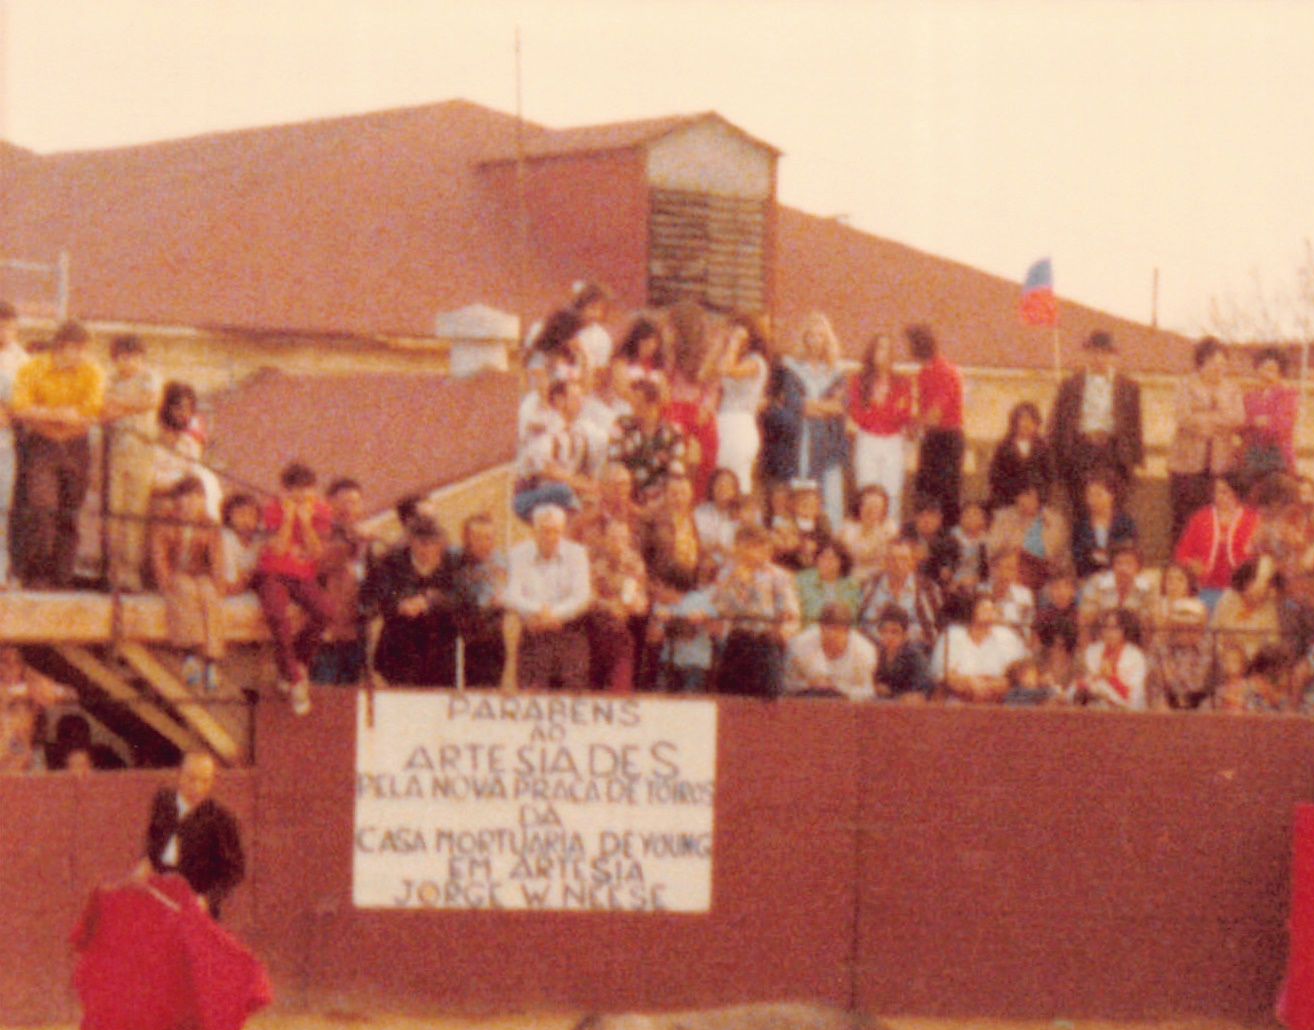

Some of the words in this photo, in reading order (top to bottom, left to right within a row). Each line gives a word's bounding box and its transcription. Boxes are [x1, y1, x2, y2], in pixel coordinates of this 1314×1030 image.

[447, 694, 641, 727] PARABENS
[530, 723, 566, 742] AO
[402, 743, 582, 780] ARTESIA
[358, 772, 423, 799] PELA
[431, 774, 507, 801] NOVA
[606, 777, 638, 805] DE
[518, 804, 563, 829] DA
[356, 826, 428, 853] CASA
[447, 855, 491, 880] EM
[509, 855, 645, 884] ARTESIA
[392, 878, 502, 908] JORGE
[520, 883, 550, 908] W
